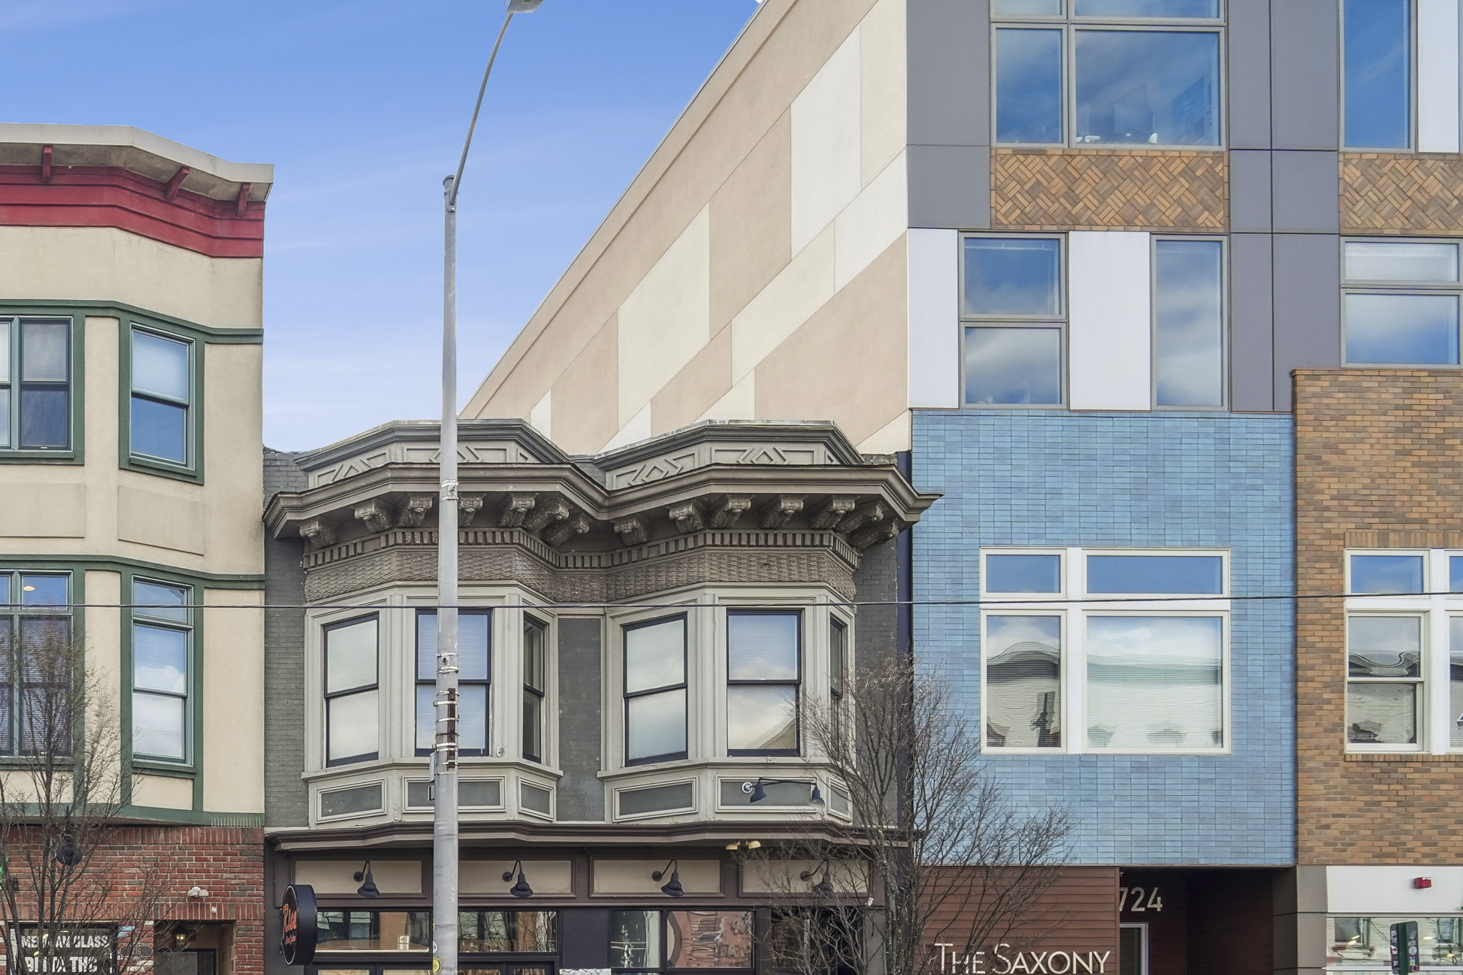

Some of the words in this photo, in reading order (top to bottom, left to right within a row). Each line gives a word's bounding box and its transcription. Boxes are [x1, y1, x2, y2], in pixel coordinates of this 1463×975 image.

[1118, 887, 1163, 912] 724
[934, 943, 986, 975] THE
[992, 943, 1111, 975] SAXONY
